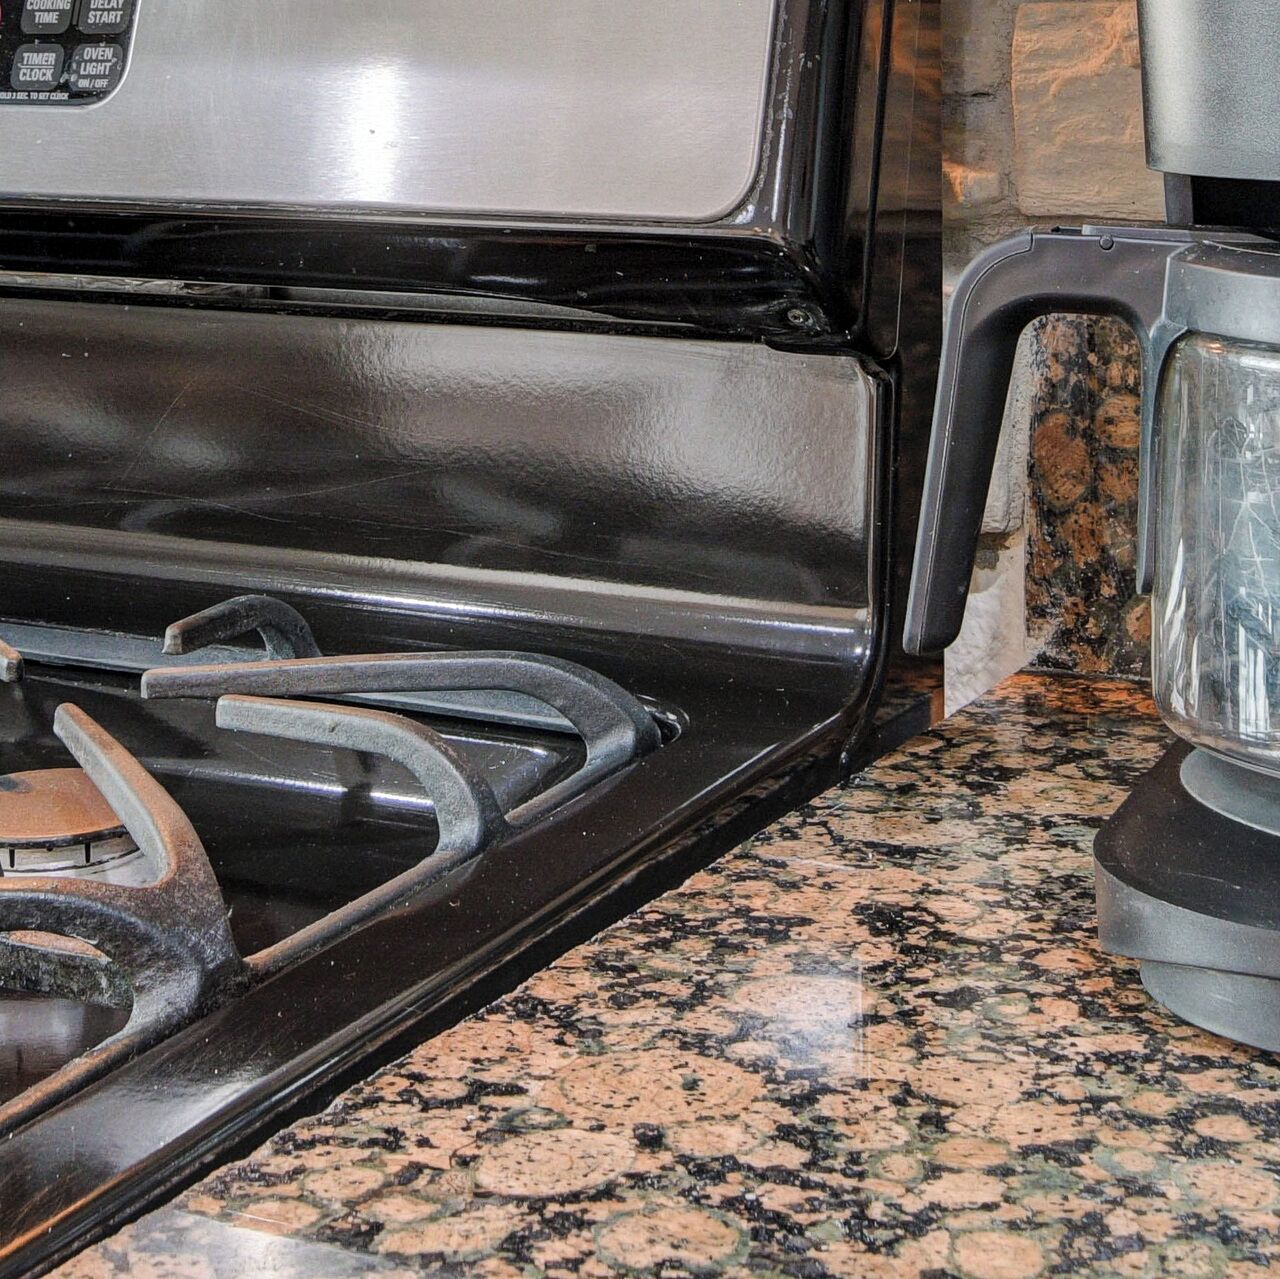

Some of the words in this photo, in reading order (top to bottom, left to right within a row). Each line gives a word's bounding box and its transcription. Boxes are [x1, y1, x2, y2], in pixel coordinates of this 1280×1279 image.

[34, 12, 59, 24] TIME
[87, 11, 124, 24] START
[22, 53, 56, 65] TIMER
[83, 47, 113, 60] OVEN
[80, 62, 112, 75] LIGHT
[19, 69, 53, 81] CLOCK
